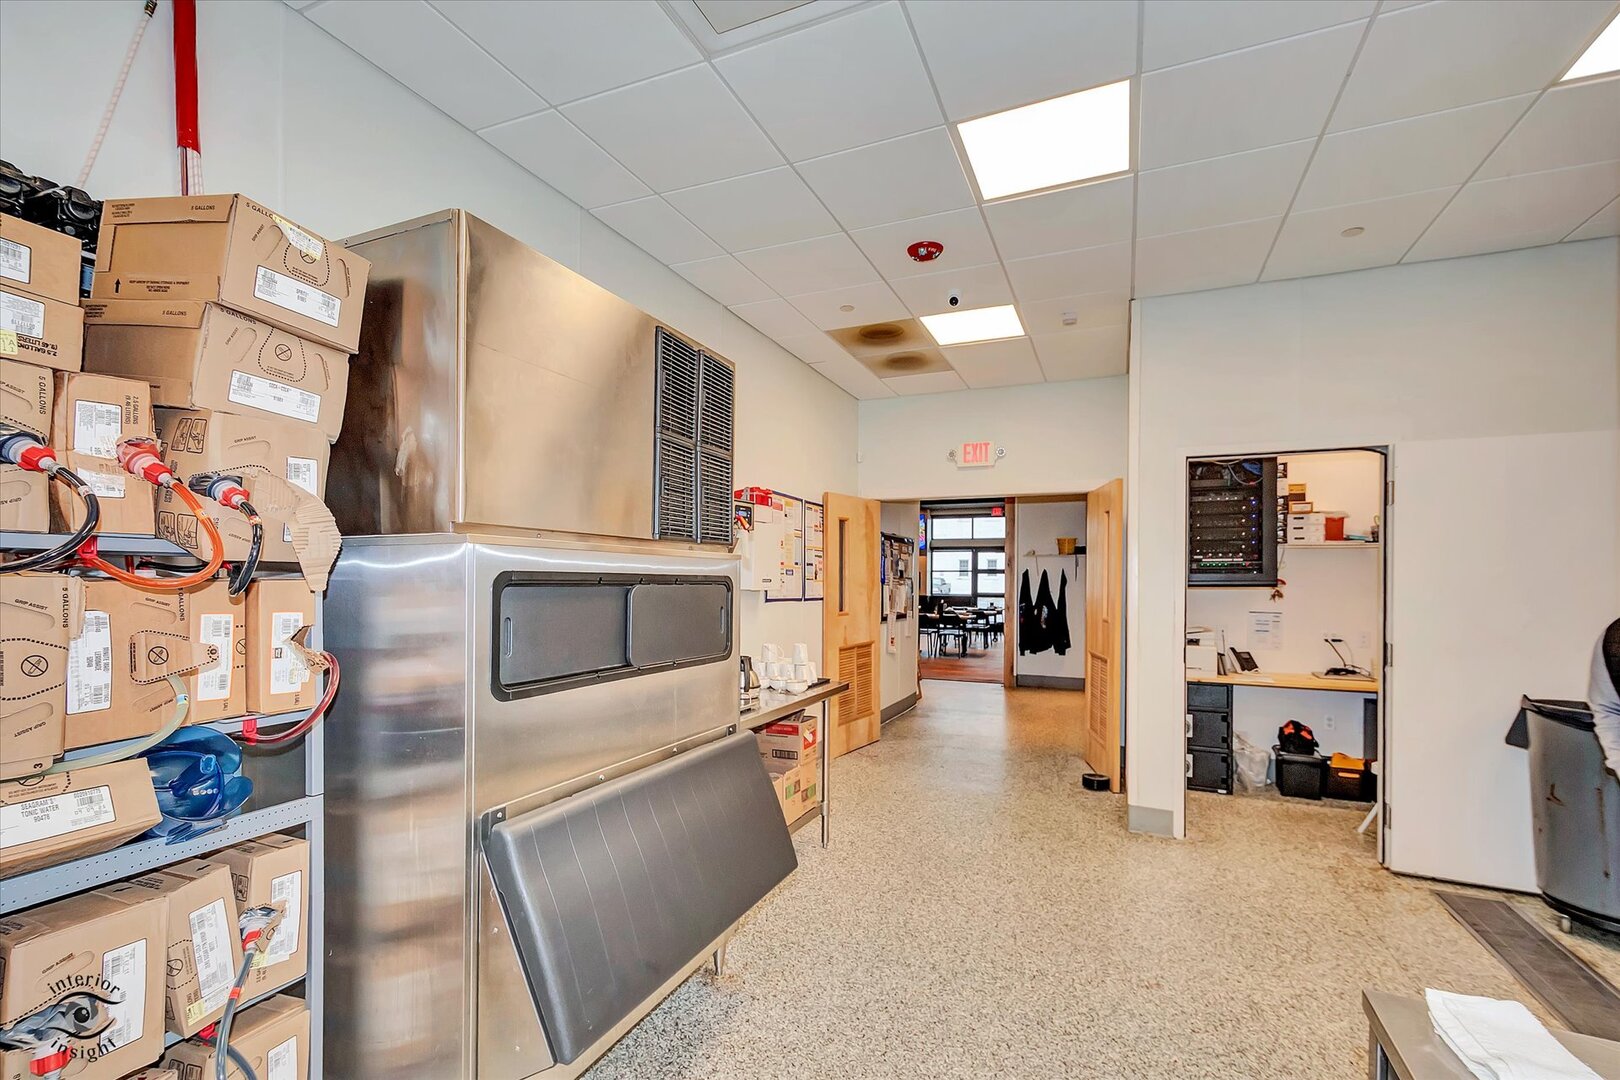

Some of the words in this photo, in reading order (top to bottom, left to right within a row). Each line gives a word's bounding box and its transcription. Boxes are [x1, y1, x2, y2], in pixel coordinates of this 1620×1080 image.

[226, 309, 257, 325] GALLONS
[38, 382, 46, 414] GALLONS
[963, 442, 990, 463] EXIT
[28, 602, 48, 610] ASSIST
[14, 727, 33, 738] ASSIST
[34, 721, 46, 730] GRIP
[21, 808, 39, 818] TONIC
[40, 804, 60, 814] WATER
